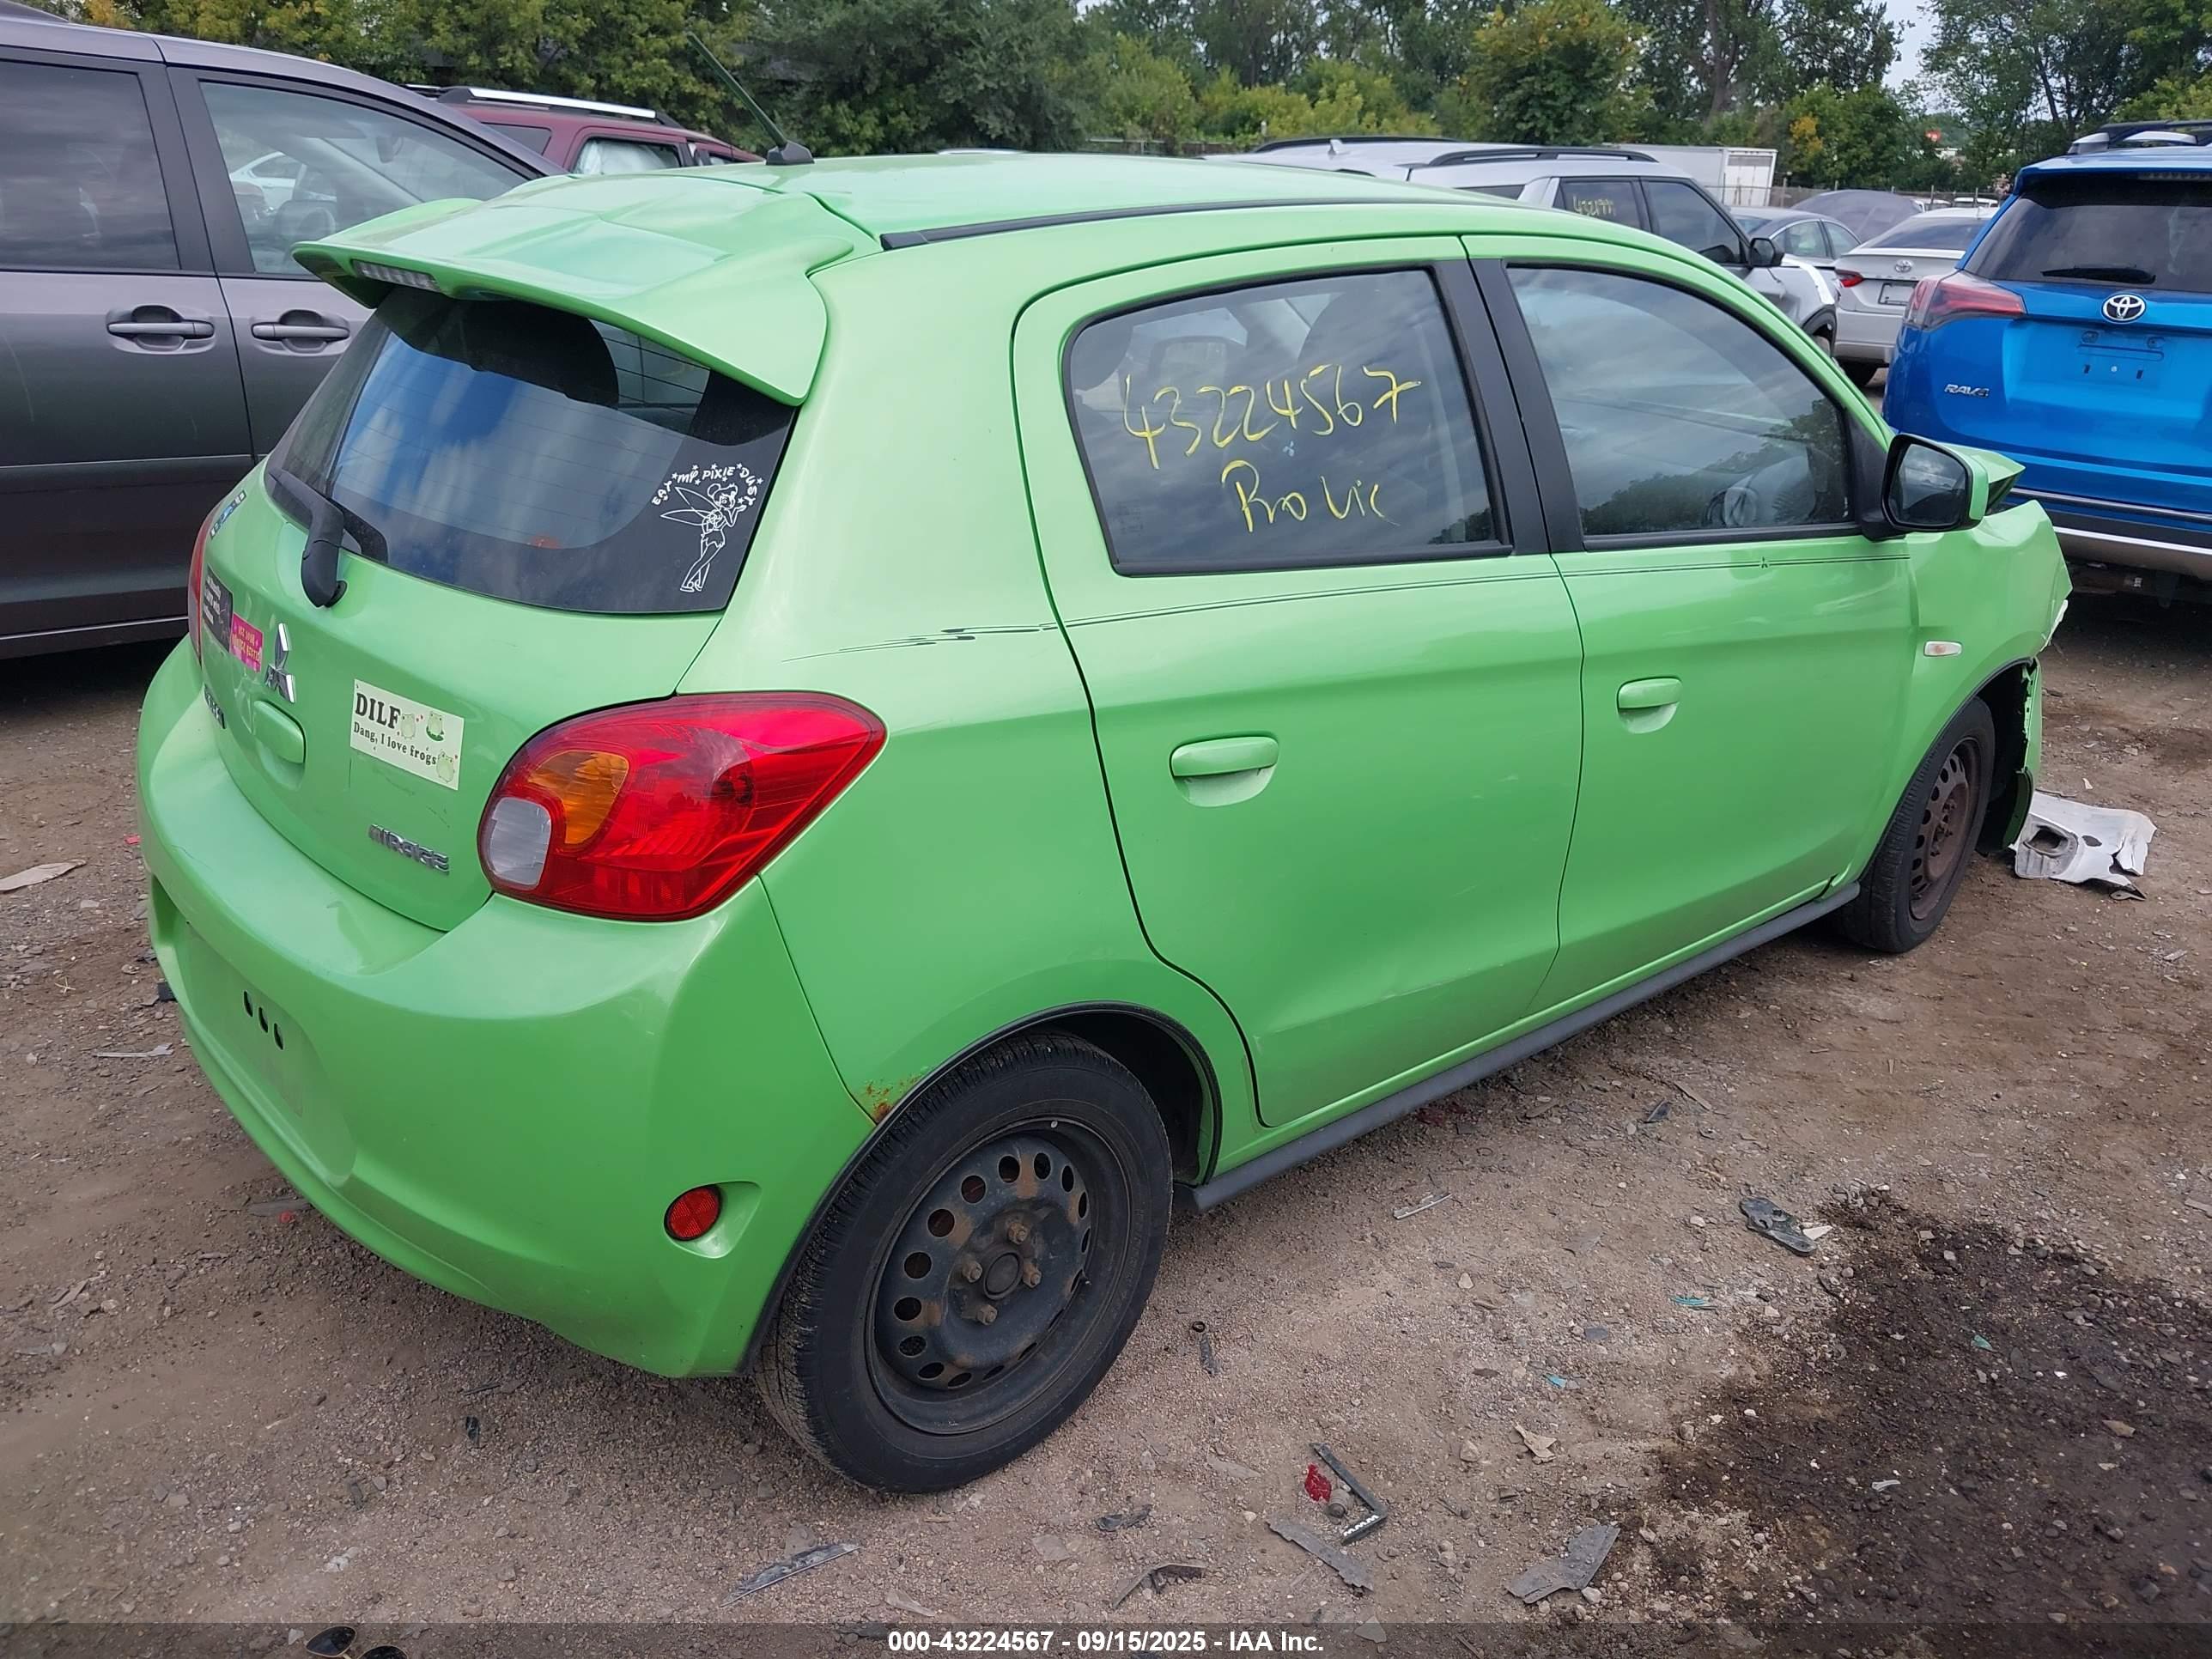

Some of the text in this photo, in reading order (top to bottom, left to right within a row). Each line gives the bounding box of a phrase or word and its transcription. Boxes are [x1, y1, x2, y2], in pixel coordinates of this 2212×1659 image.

[1123, 363, 1421, 471] 43224567
[355, 691, 402, 729] DILF
[353, 720, 437, 766] Dang, I love frogs
